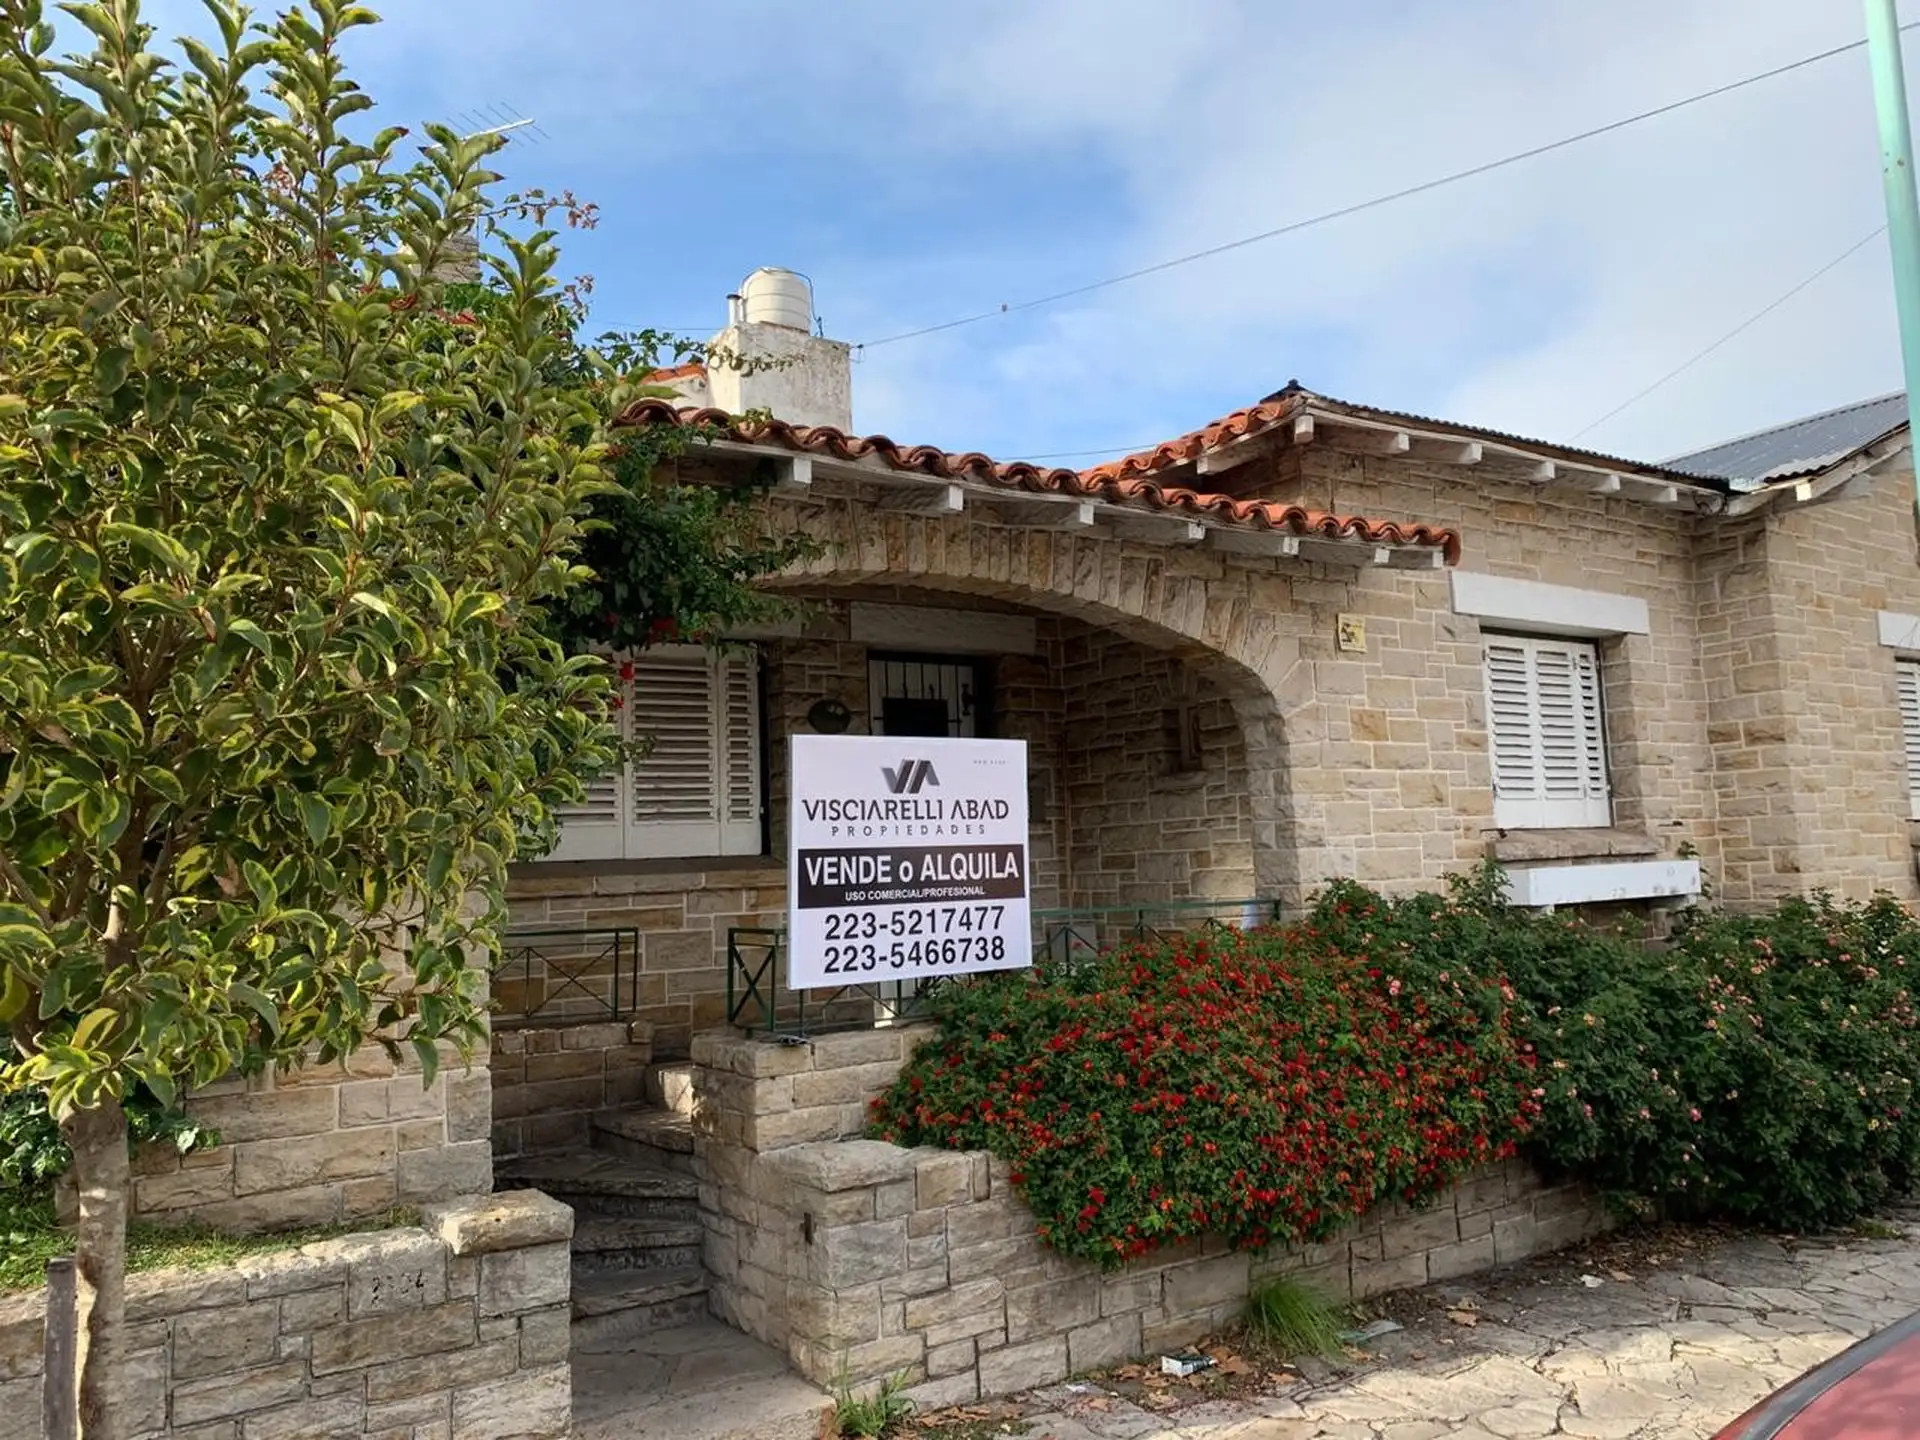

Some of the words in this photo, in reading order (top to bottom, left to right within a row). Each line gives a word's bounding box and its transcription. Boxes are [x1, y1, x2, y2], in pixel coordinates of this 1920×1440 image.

[802, 799, 943, 821] VISCIARELLI
[950, 800, 1009, 820] ABAD
[831, 825, 985, 836] PROPIEDADES
[805, 855, 892, 886] VENDE
[919, 852, 1019, 882] ALQUILA
[845, 891, 866, 901] USO
[824, 905, 1005, 941] 223-5217477
[823, 935, 1005, 974] 223-5466738
